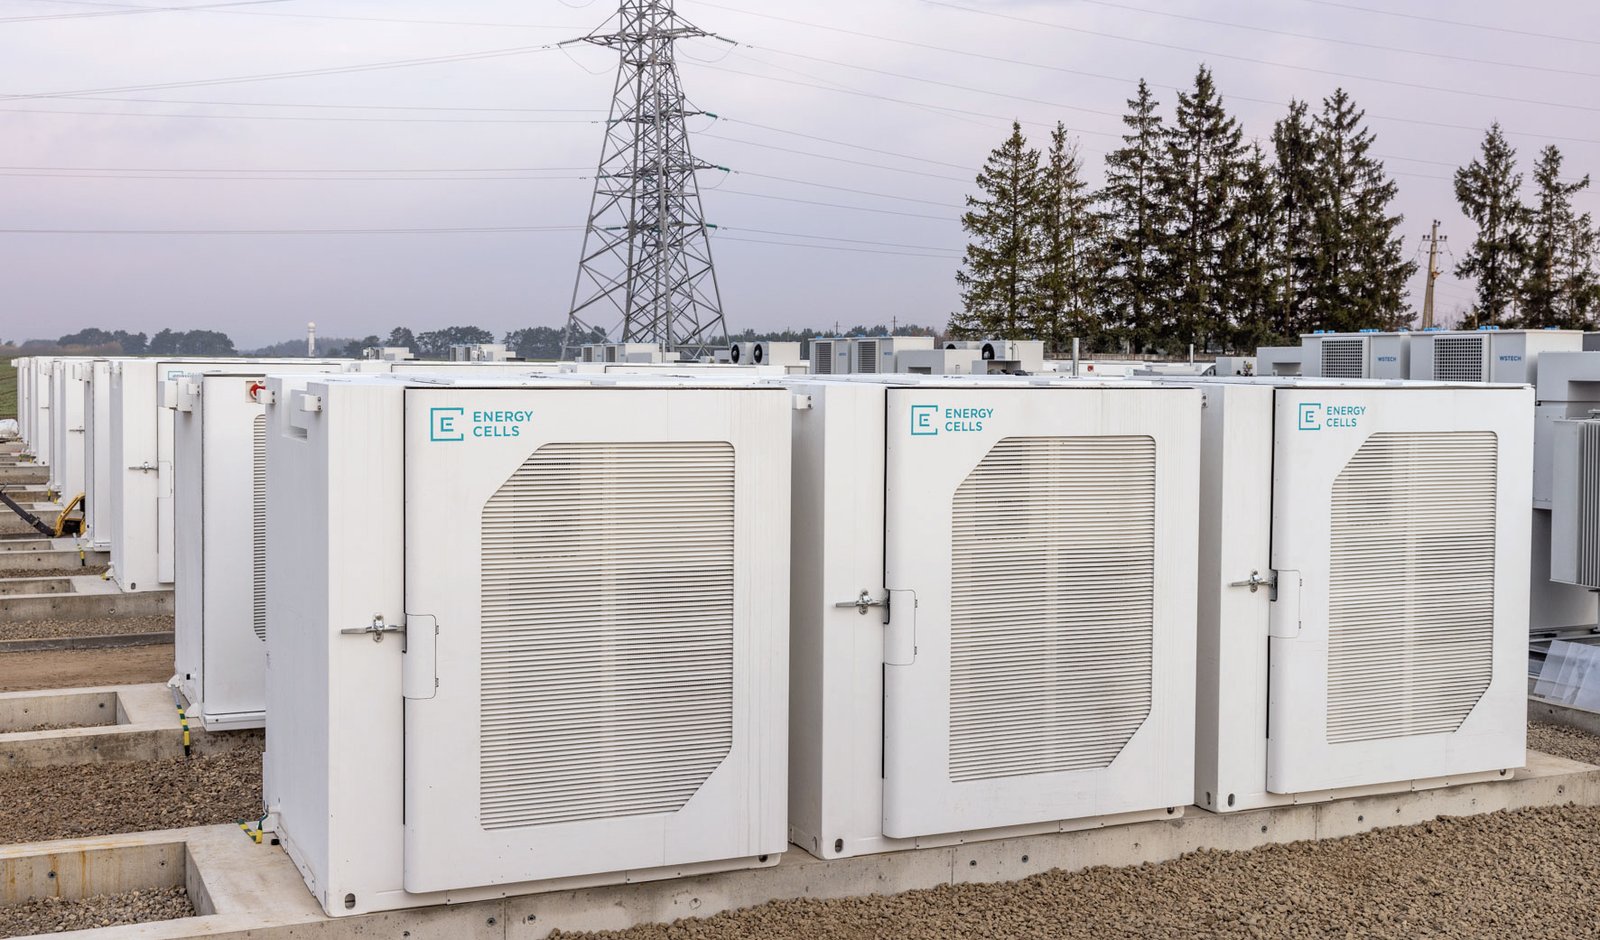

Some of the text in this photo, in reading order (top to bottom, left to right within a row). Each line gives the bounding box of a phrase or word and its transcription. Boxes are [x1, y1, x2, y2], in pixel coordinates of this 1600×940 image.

[473, 410, 533, 422] ENERGY
[945, 408, 993, 419] ENERGY
[1326, 405, 1366, 416] ENERGY
[945, 421, 983, 432] CELLS
[1326, 418, 1358, 428] CELLS
[472, 425, 520, 437] CELLS
